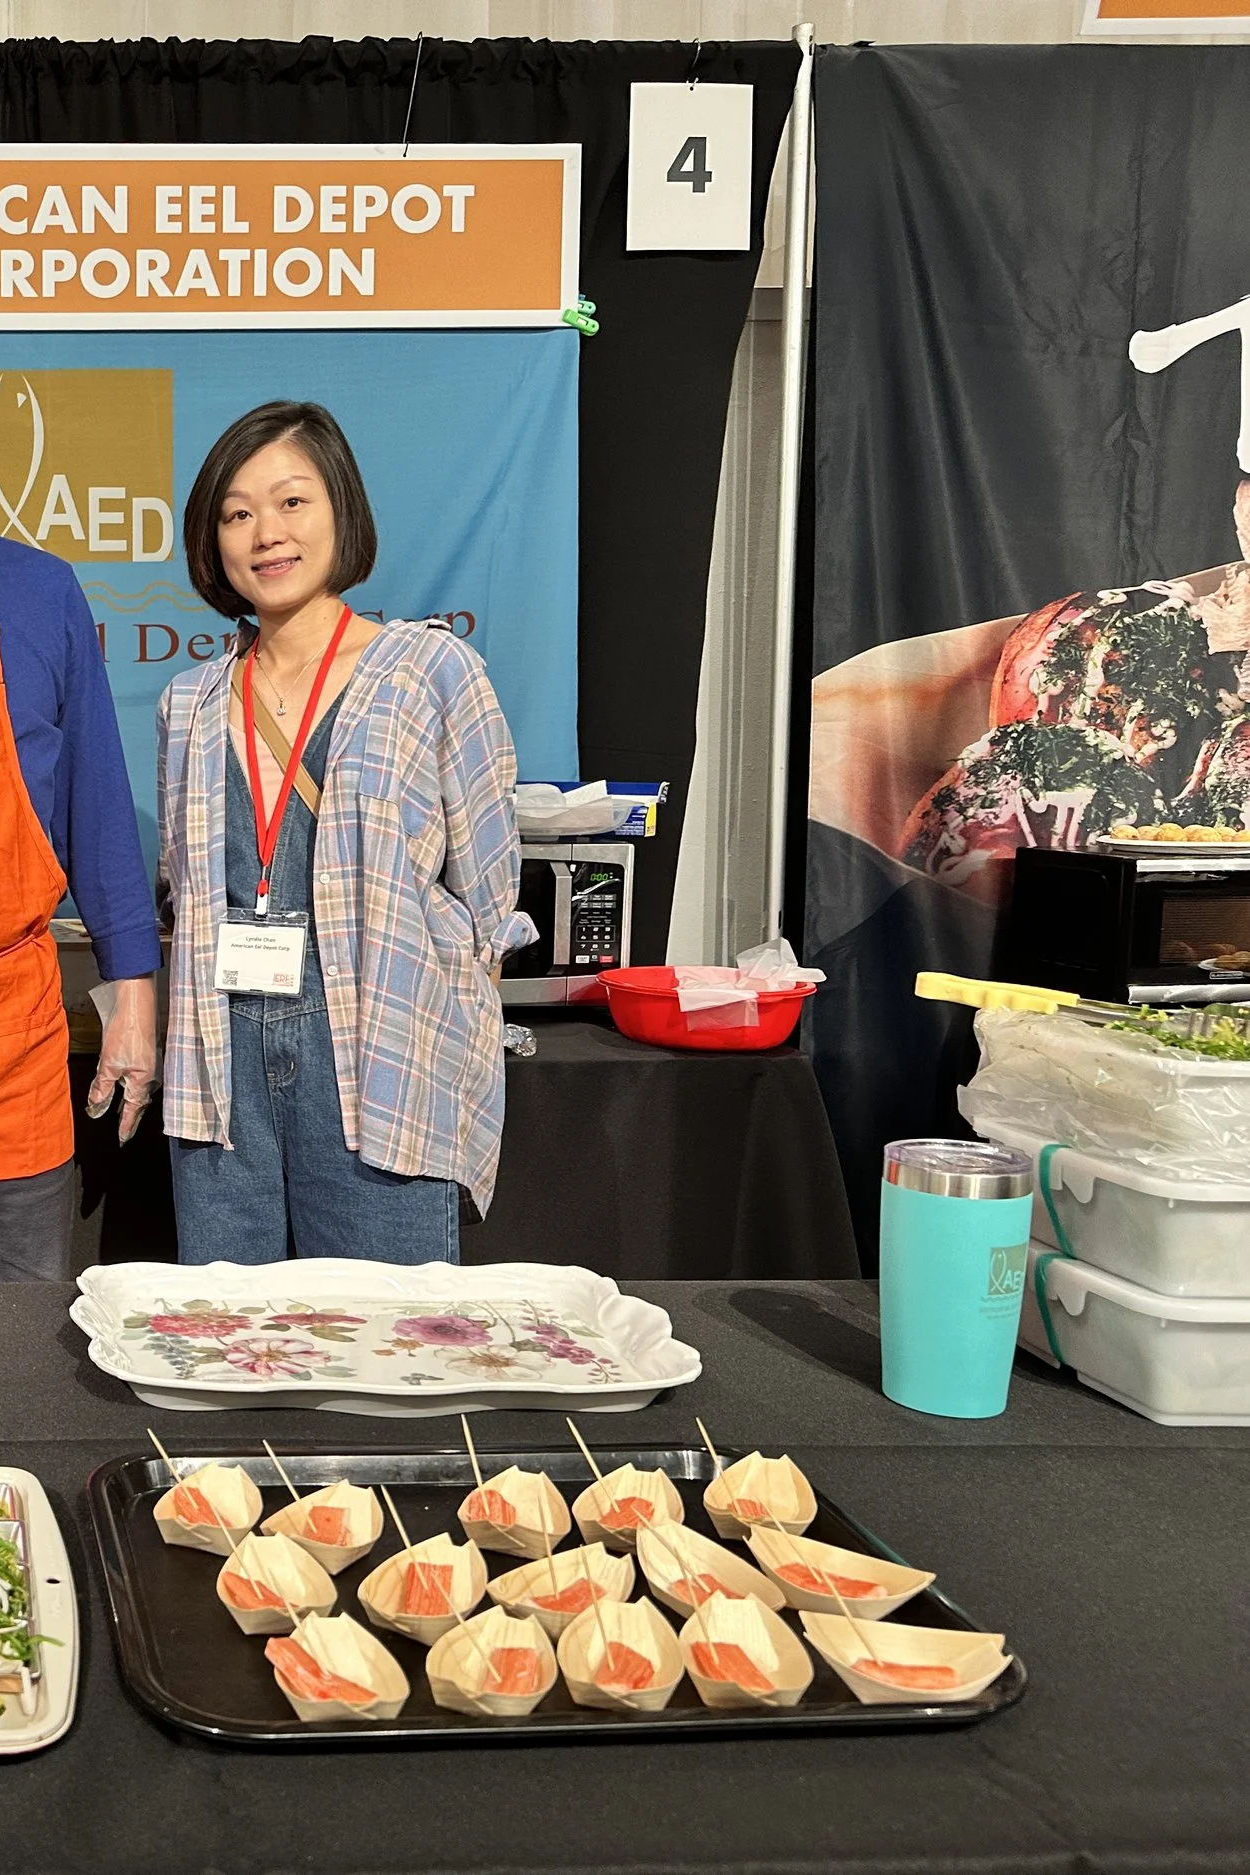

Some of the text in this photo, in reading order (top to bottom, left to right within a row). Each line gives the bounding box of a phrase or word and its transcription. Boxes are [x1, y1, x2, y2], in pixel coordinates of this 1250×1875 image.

[666, 136, 712, 193] 4
[155, 185, 249, 234] EEL
[273, 183, 475, 234] DEPOT
[35, 474, 173, 562] AED
